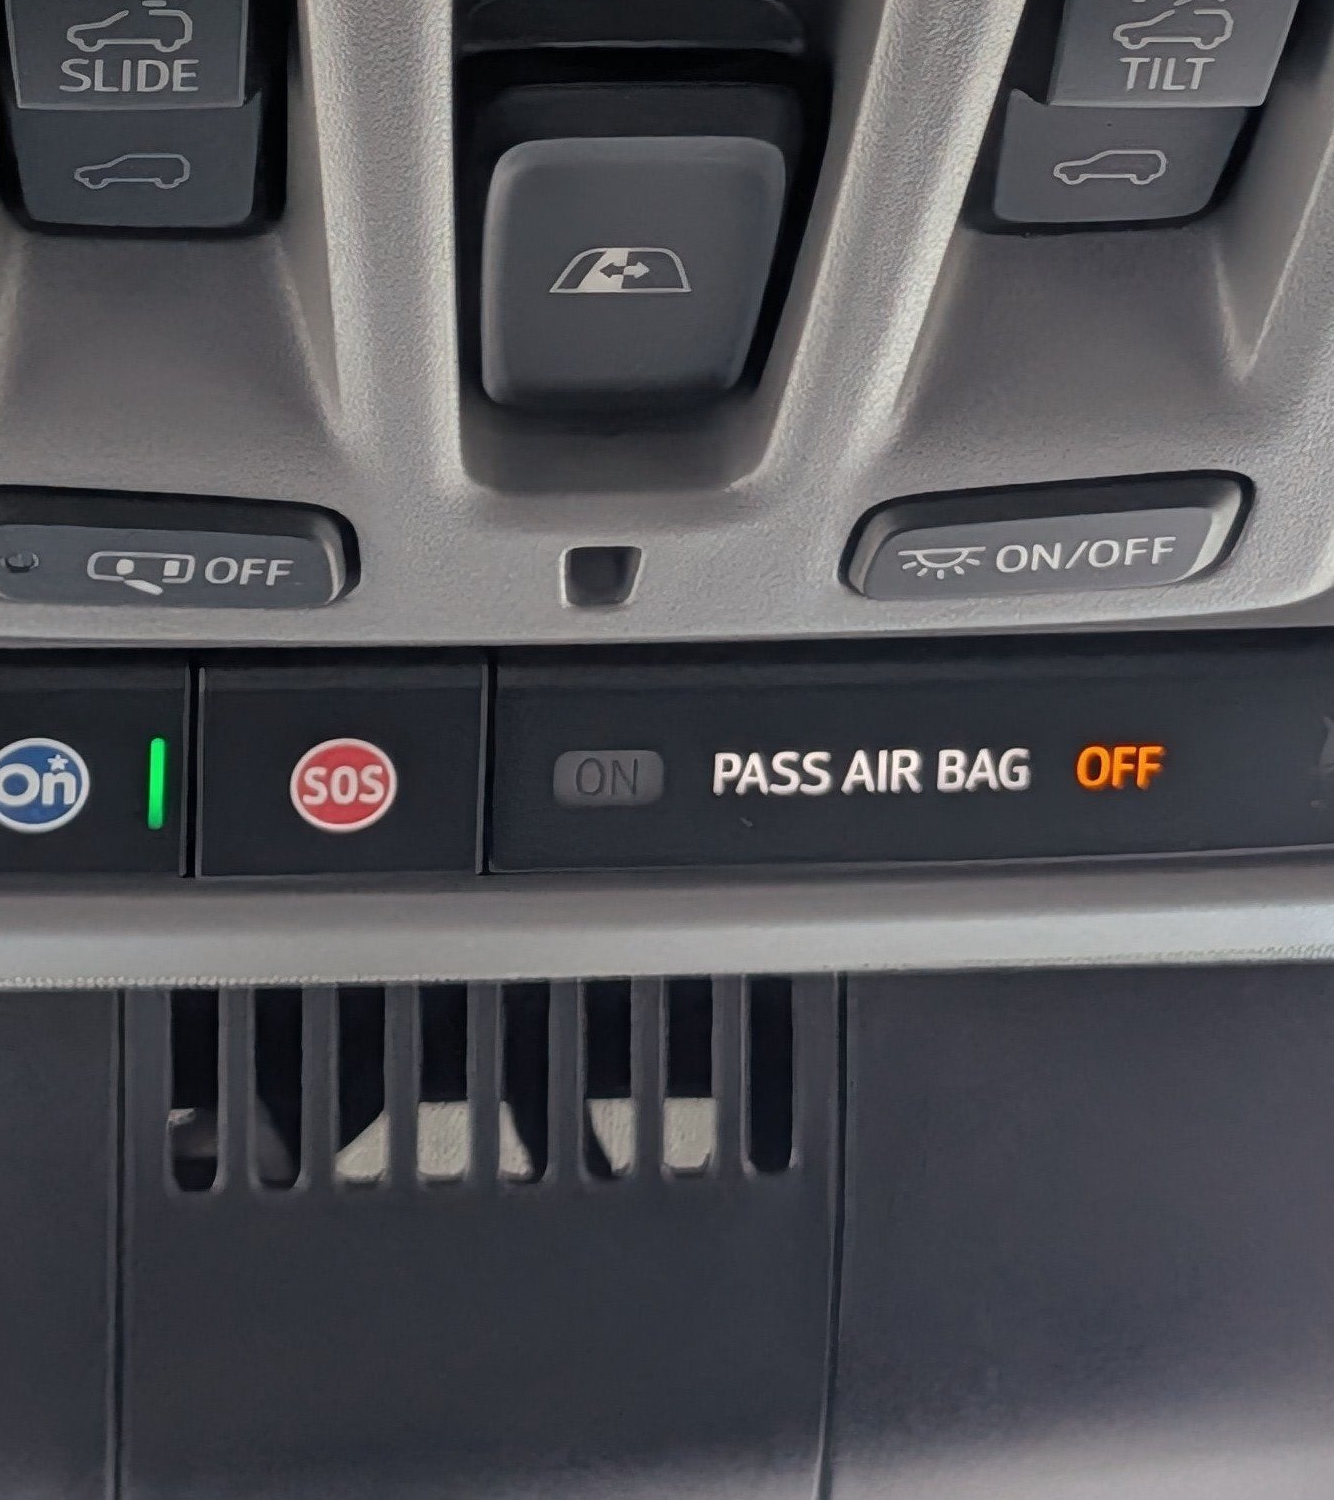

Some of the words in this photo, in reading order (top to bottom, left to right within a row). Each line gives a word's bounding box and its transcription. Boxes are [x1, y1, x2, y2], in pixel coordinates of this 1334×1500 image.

[59, 58, 200, 93] SLIDE
[1119, 57, 1216, 91] TILT
[204, 556, 294, 586] OFF
[996, 536, 1177, 574] ON/OFF
[302, 763, 388, 807] SOS
[574, 758, 641, 796] ON
[713, 751, 831, 794] PASS
[841, 749, 921, 793] AIR
[936, 747, 1030, 790] BAG
[1076, 745, 1164, 788] OFF
